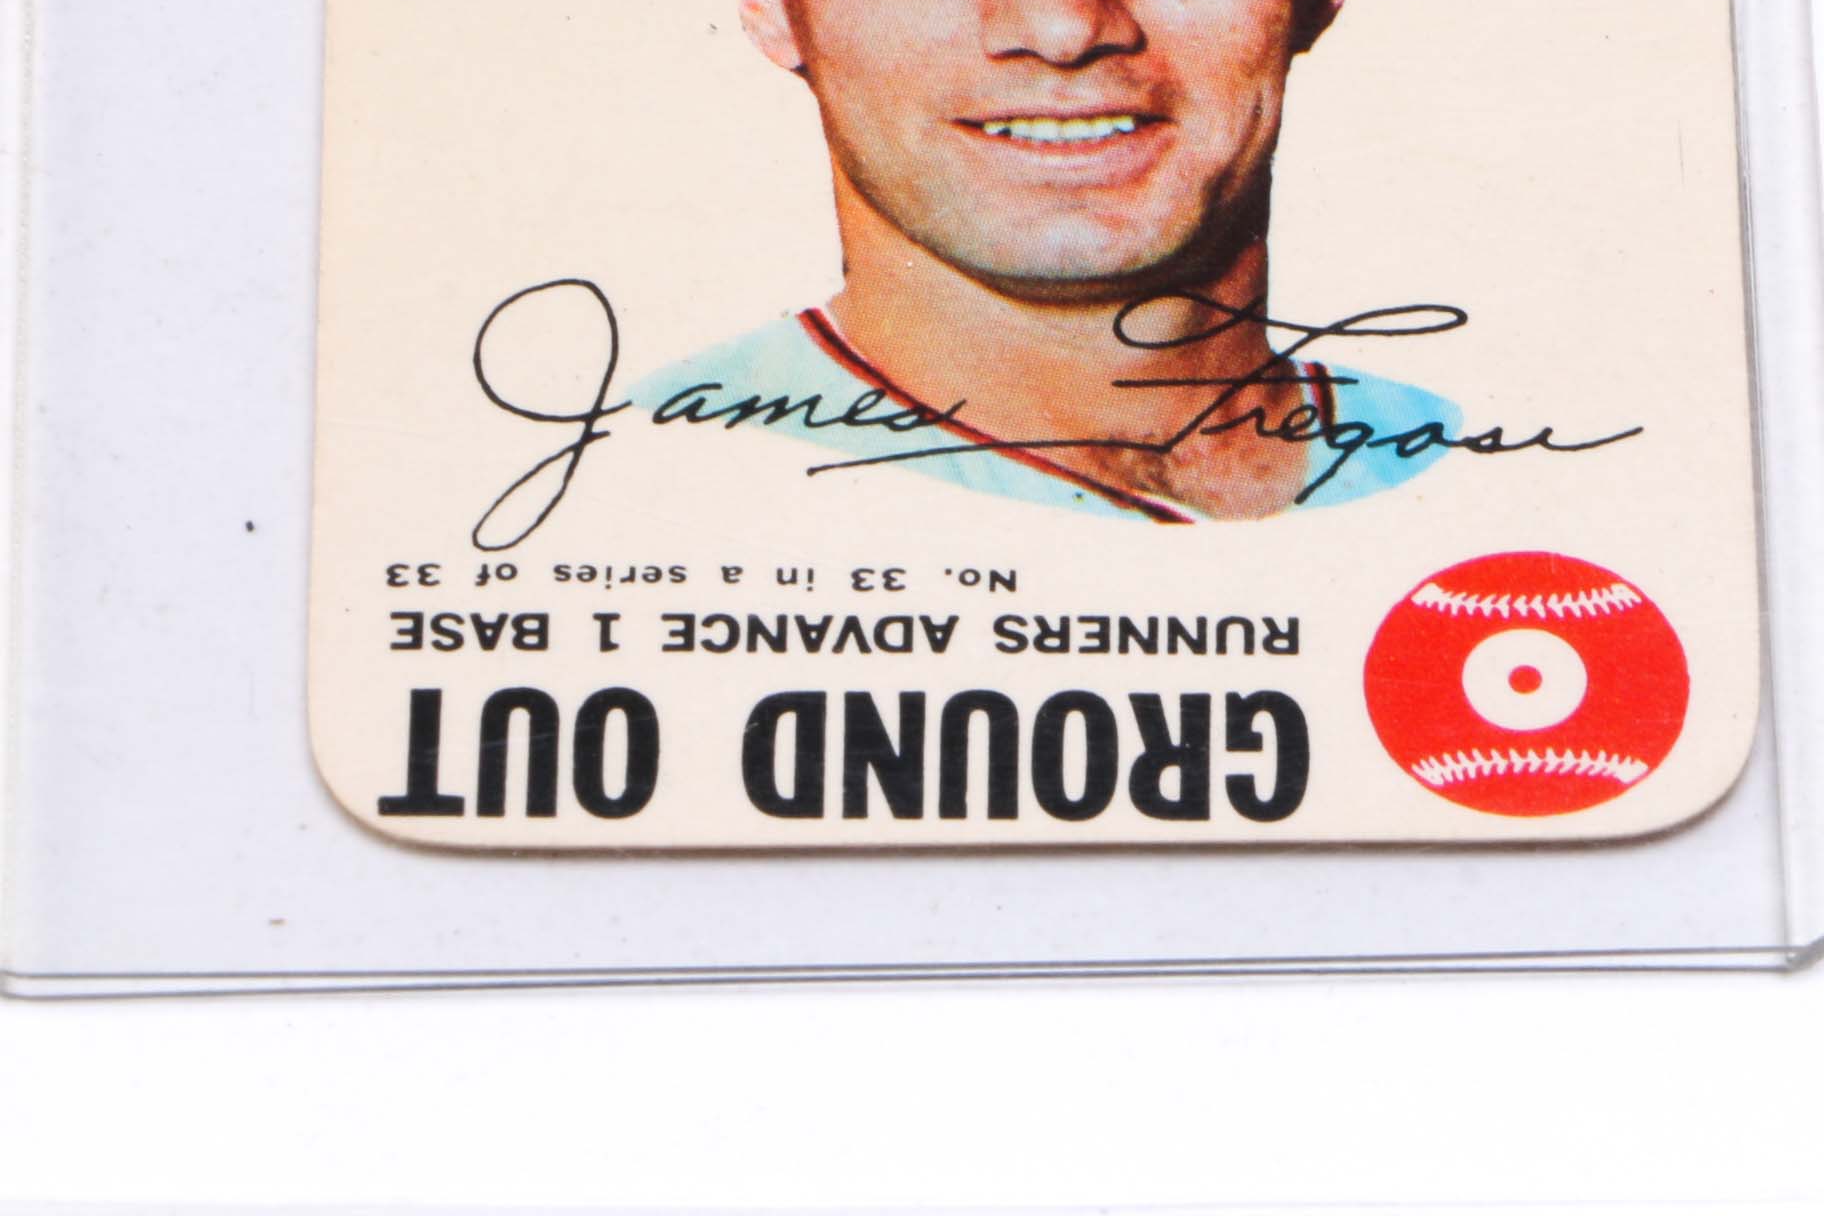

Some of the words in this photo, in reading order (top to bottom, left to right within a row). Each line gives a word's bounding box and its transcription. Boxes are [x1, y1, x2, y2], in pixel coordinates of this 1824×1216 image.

[385, 563, 442, 587] 33
[475, 562, 519, 586] of
[553, 564, 688, 590] series
[720, 565, 744, 584] a
[776, 569, 815, 591] in
[851, 567, 907, 592] 33
[946, 568, 1017, 592] No.
[392, 613, 548, 650] BASE
[594, 614, 619, 651] 1
[663, 615, 958, 653] ADVANCE
[994, 616, 1298, 654] RUNNERS
[379, 688, 659, 818] OUT
[743, 691, 1309, 821] GROUND
